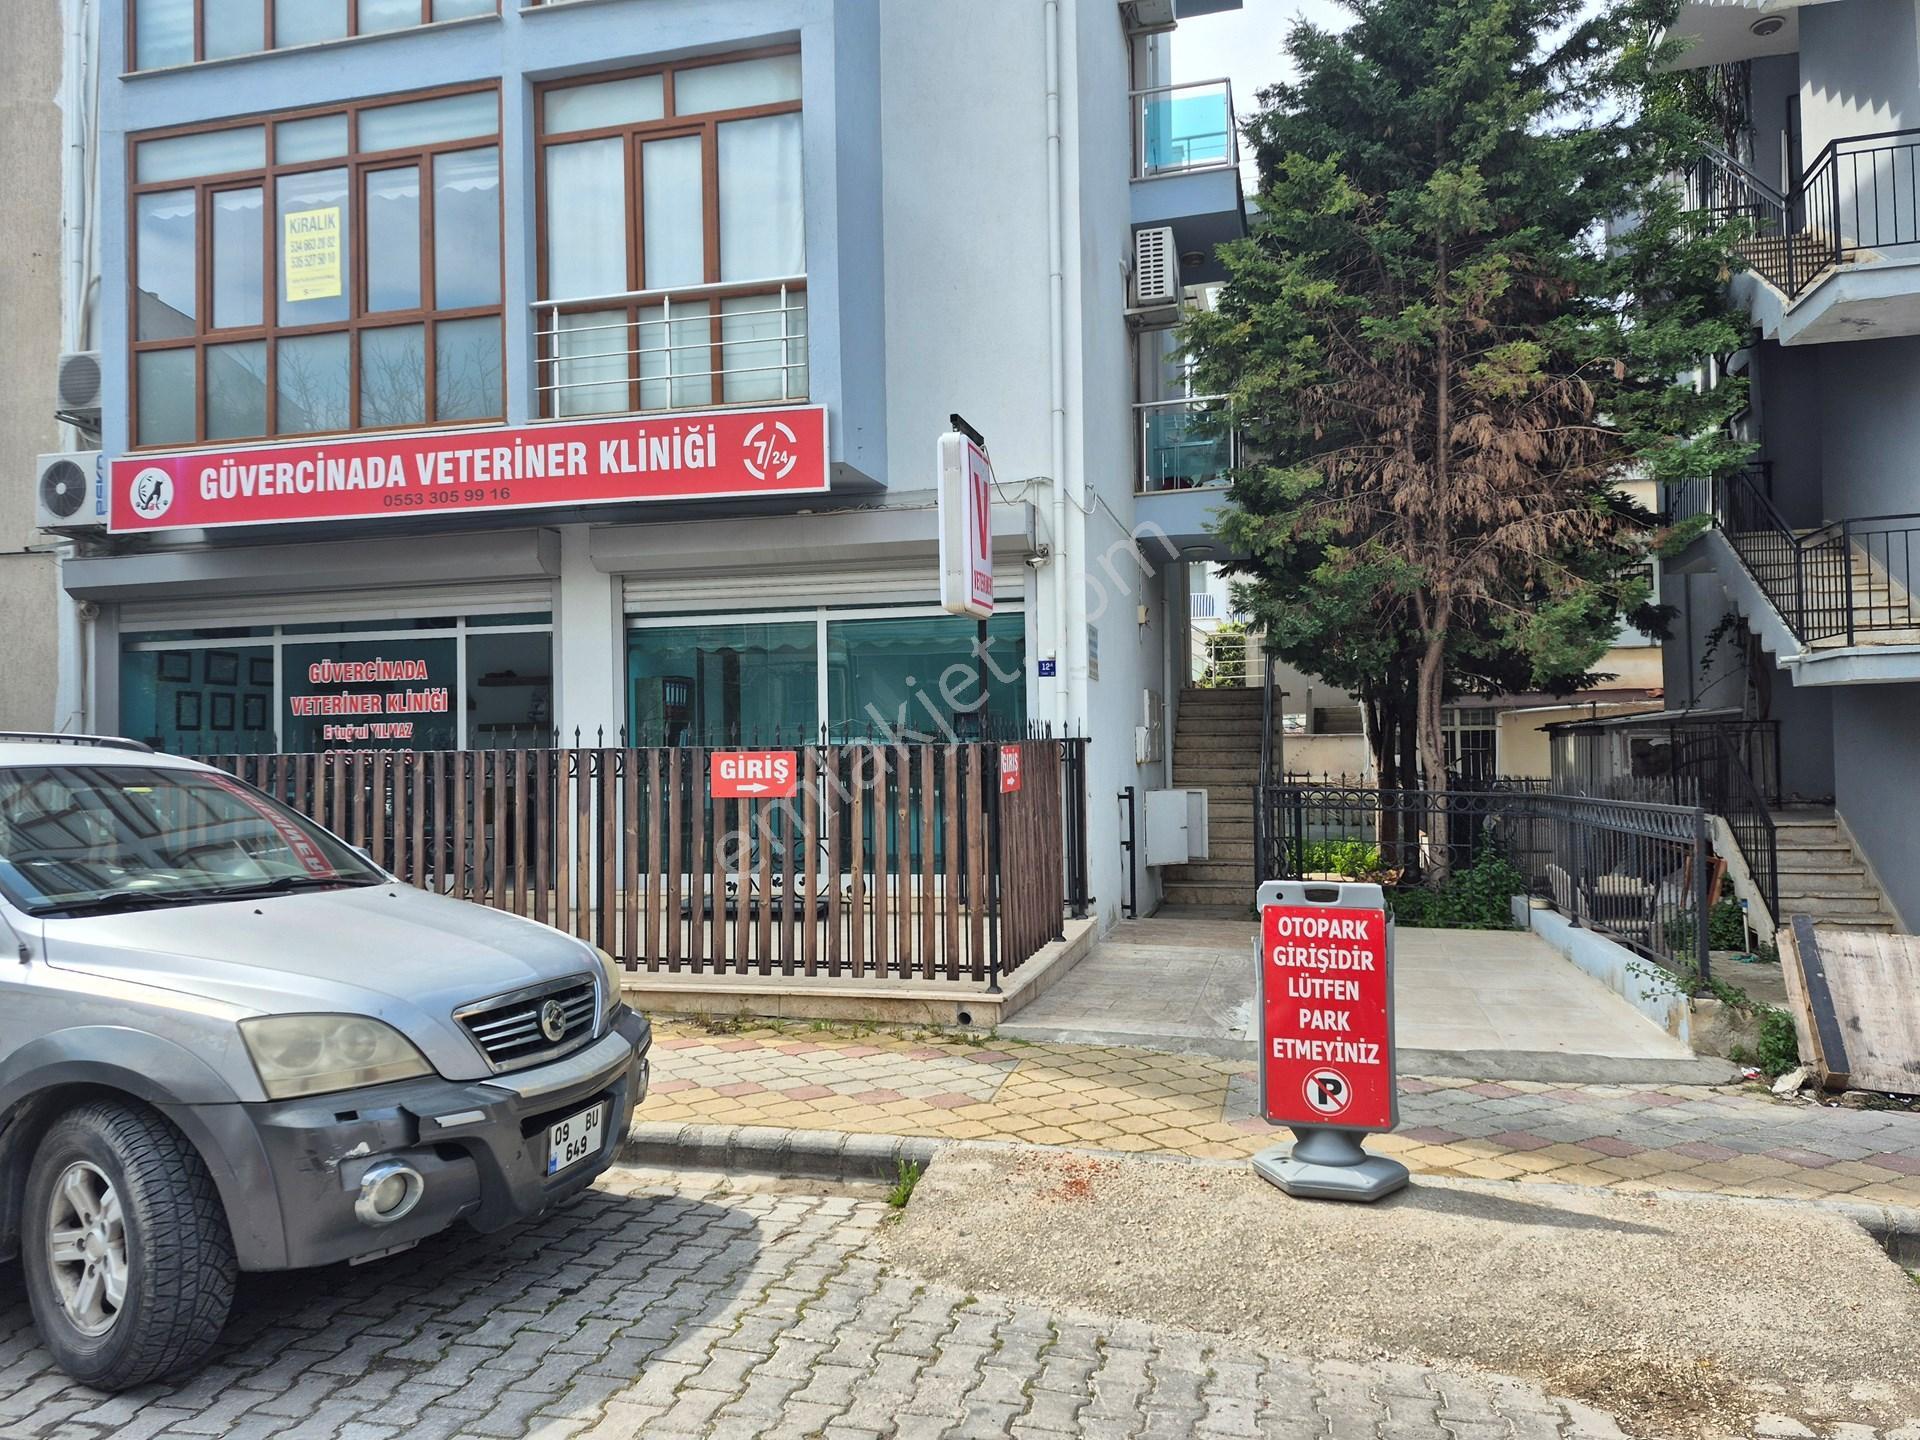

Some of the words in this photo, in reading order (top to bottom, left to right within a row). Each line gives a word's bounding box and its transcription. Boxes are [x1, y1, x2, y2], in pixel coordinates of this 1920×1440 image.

[200, 452, 406, 500] GÜVERCİNADA
[415, 438, 588, 486] VETERİNER
[599, 424, 717, 475] KLİNİĞİ
[754, 433, 788, 470] 7/24
[383, 494, 424, 508] 0553
[428, 491, 460, 505] 305
[464, 489, 485, 502] 99
[490, 487, 510, 500] 16
[974, 472, 988, 560] V
[309, 657, 428, 683] GÜVERCİNADA
[290, 691, 384, 716] VETERİNER
[386, 687, 449, 714] KLİNİĞİ
[323, 724, 369, 742] Ertuğrul
[369, 723, 413, 739] YILMAZ
[720, 755, 789, 783] GİRİŞ
[1001, 749, 1018, 776] GİRİŞ
[1278, 916, 1369, 941] OTOPARK
[1273, 941, 1375, 974] GİRİŞİDİR
[1288, 973, 1360, 1001] LÜTFEN
[1299, 1008, 1351, 1032] PARK
[1272, 1036, 1380, 1065] ETMEYİNİZ
[556, 1124, 570, 1146] 09
[586, 1108, 599, 1132] BU
[566, 1137, 588, 1161] 649
